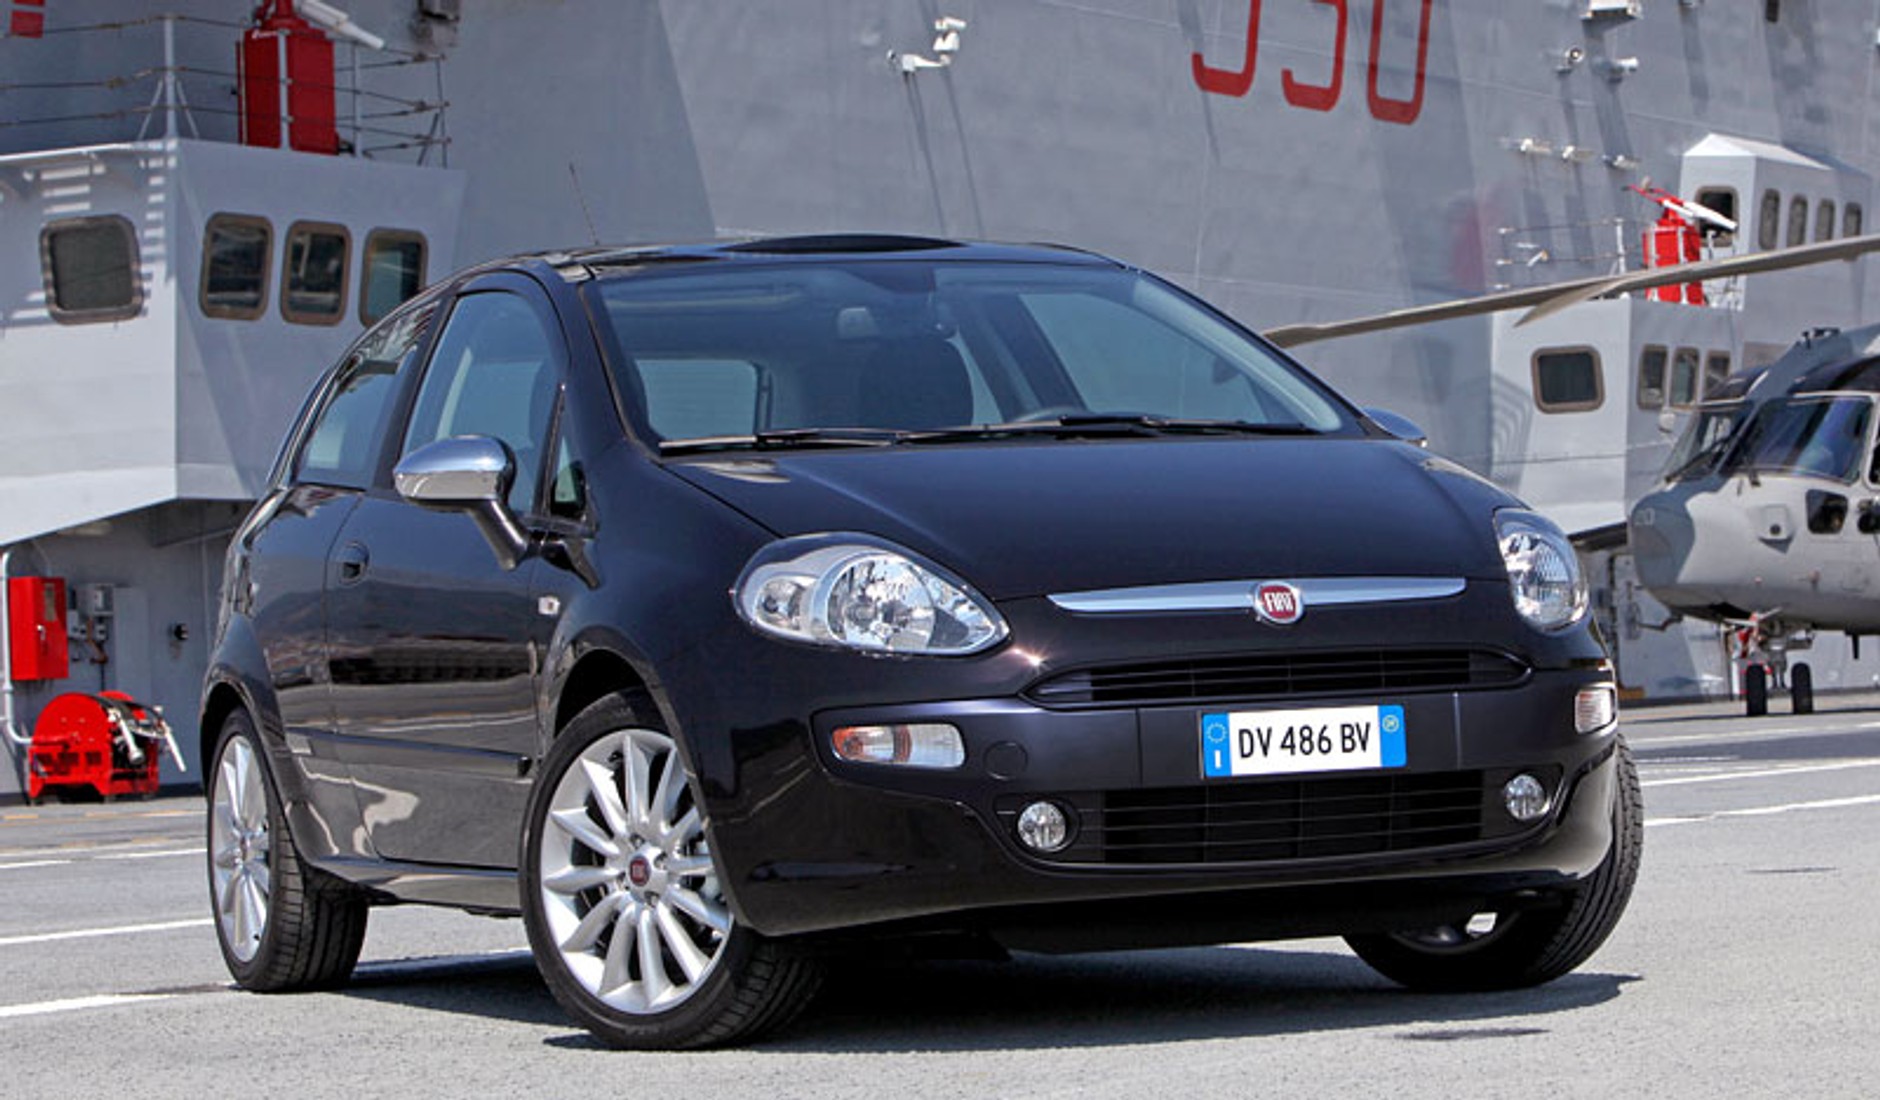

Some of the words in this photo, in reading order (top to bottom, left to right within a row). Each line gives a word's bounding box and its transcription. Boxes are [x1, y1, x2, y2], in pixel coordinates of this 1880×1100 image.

[1264, 592, 1293, 612] FIAT
[1238, 727, 1272, 759] DV
[1280, 724, 1332, 756] 486
[1340, 721, 1371, 753] BV
[1214, 750, 1221, 769] I
